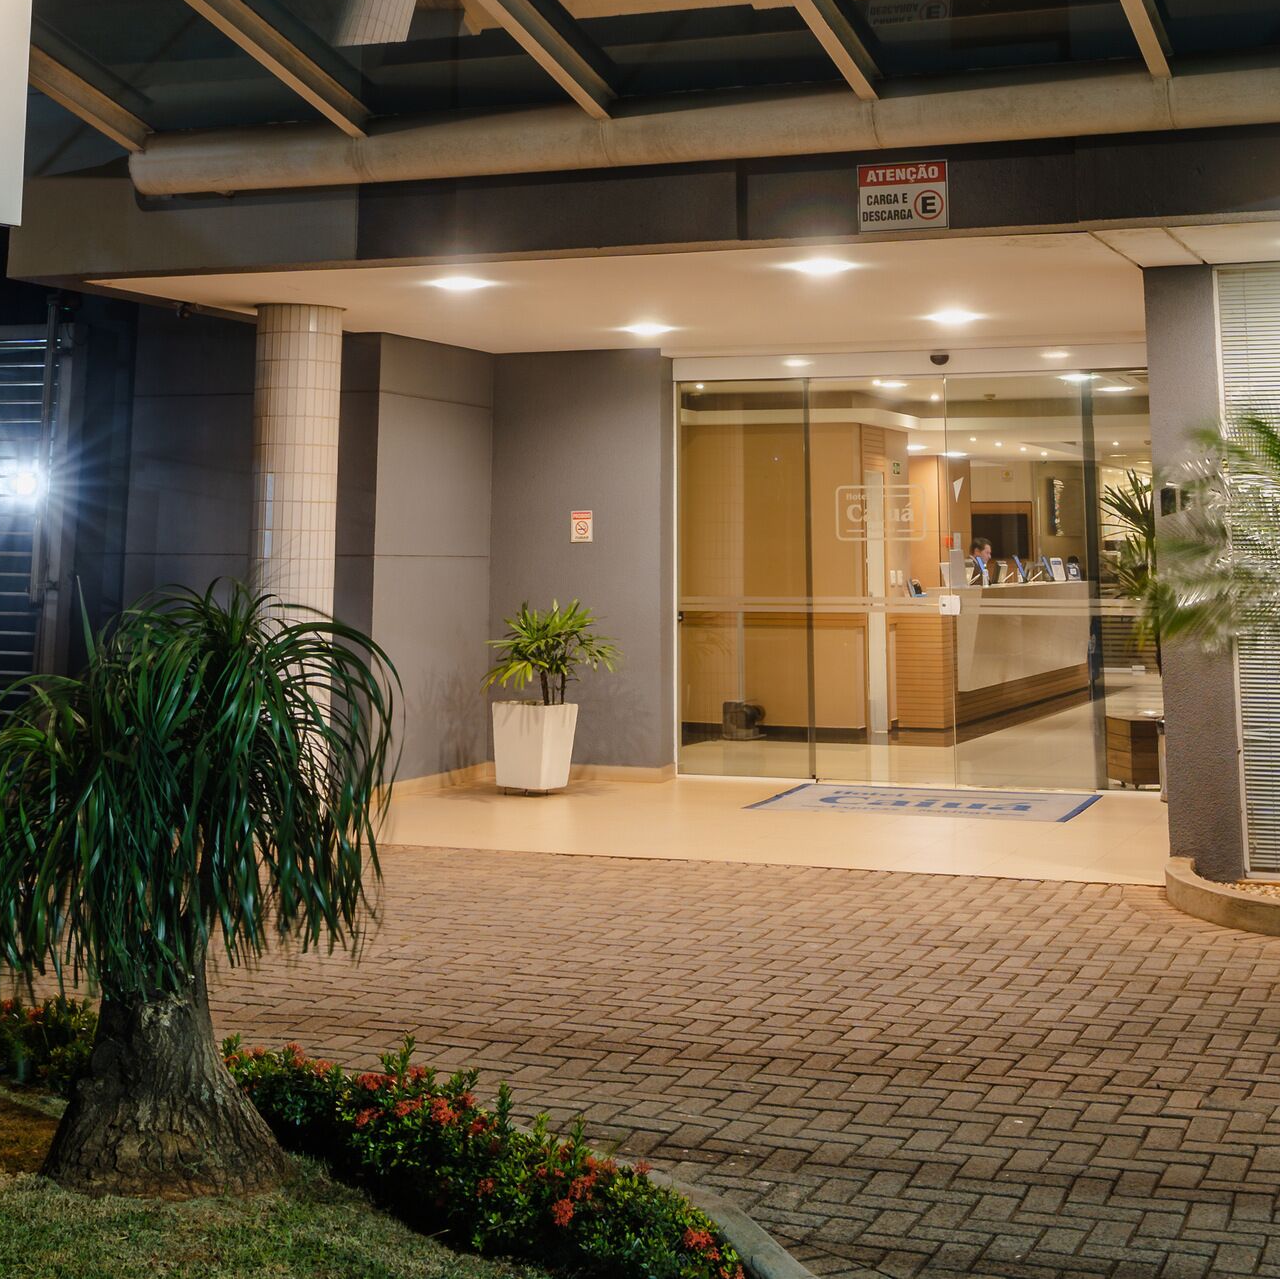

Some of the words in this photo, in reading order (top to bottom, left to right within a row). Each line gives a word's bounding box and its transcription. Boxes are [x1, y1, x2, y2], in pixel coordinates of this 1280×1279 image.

[866, 164, 939, 183] ATENÇÃO
[866, 193, 899, 206] CARGA
[902, 192, 908, 204] E
[862, 209, 913, 222] DESCARGA
